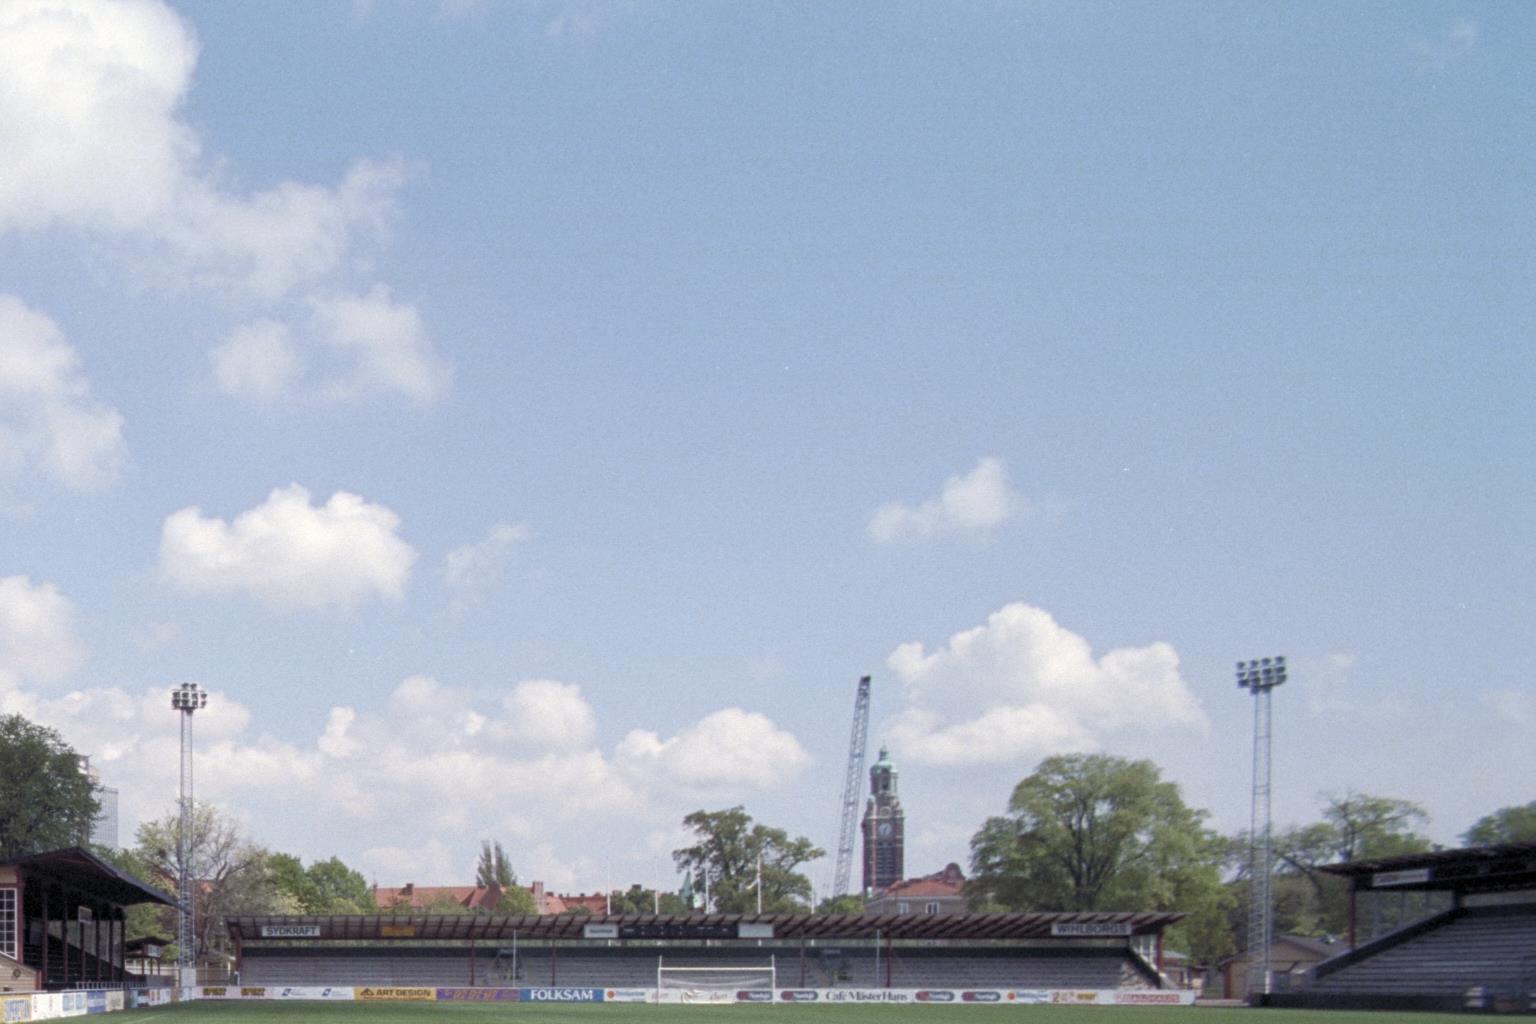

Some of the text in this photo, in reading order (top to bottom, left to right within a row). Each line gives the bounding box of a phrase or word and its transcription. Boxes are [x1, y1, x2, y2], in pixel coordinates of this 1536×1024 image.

[267, 926, 316, 936] SYDKRAFT
[395, 988, 431, 997] DESIGN
[530, 989, 593, 1001] FOLKSAM
